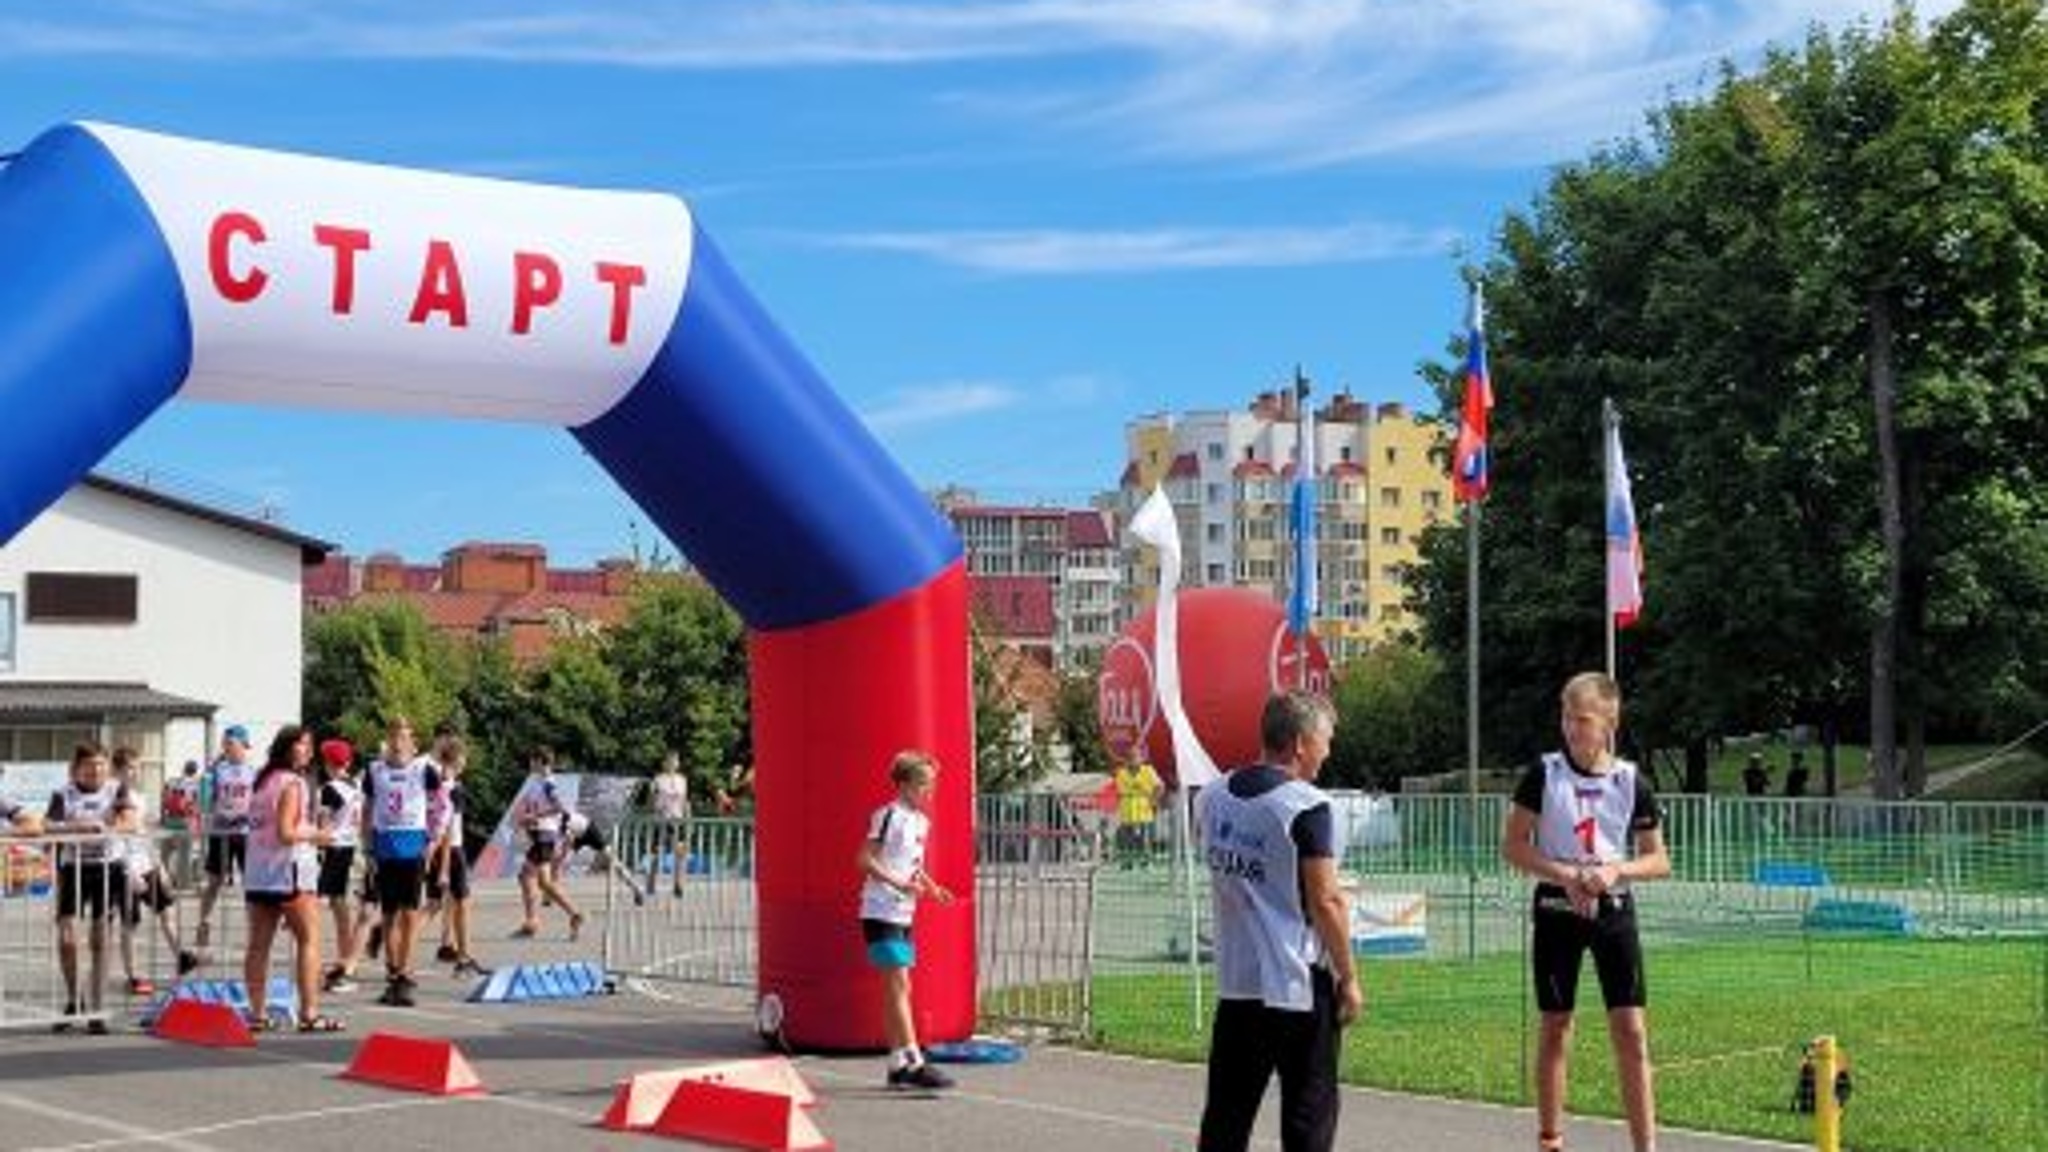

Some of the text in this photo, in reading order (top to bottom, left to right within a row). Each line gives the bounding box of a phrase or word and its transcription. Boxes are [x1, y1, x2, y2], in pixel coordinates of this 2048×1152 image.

[208, 211, 646, 345] СТАРТ
[388, 787, 402, 813] 3
[1573, 816, 1596, 854] 1
